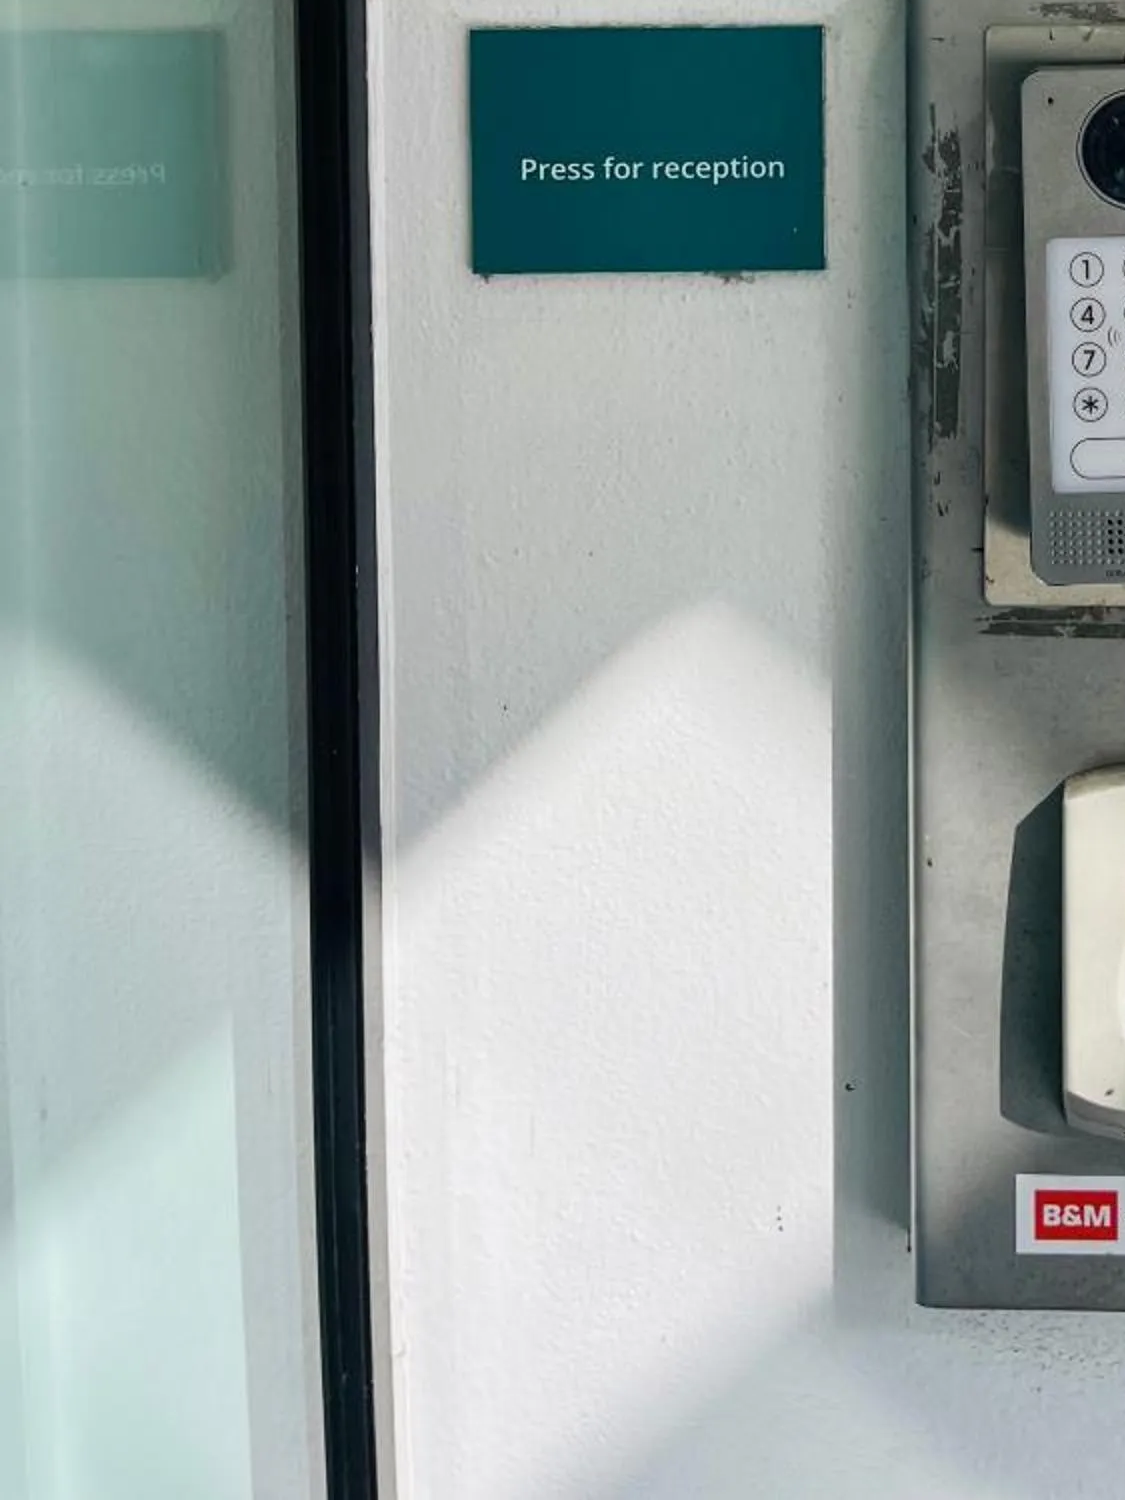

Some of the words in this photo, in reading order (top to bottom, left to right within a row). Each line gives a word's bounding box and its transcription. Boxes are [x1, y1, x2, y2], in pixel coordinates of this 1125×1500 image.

[521, 157, 595, 181] Press
[602, 155, 645, 180] for
[652, 155, 785, 186] reception
[1080, 304, 1095, 325] 4
[1083, 349, 1096, 371] 7
[1042, 1203, 1112, 1228] B&M
